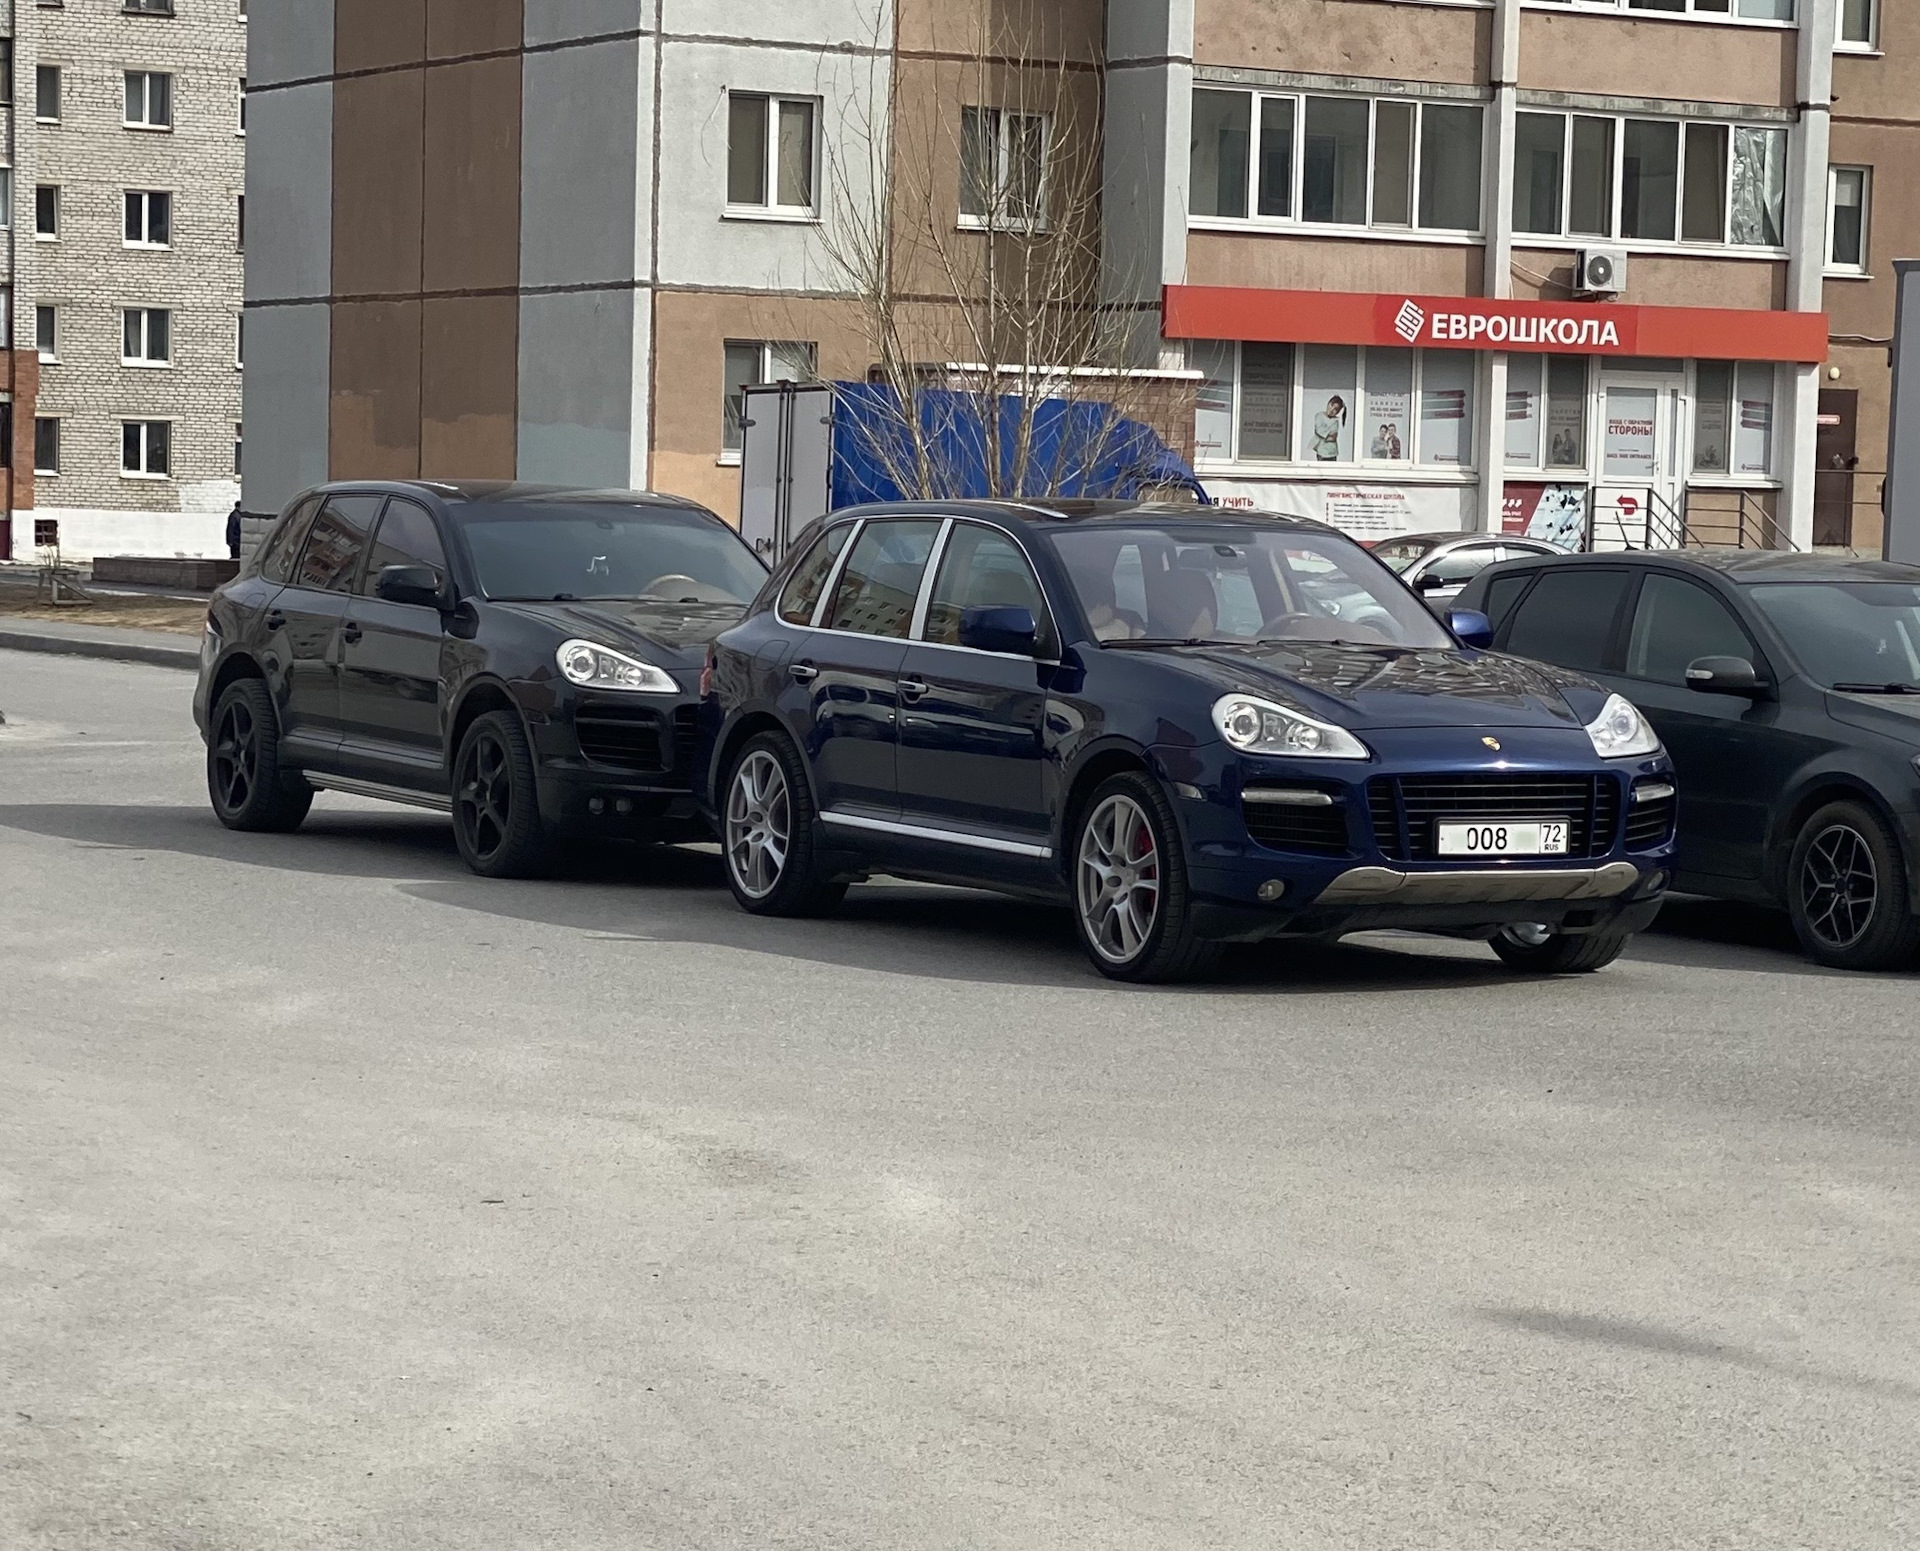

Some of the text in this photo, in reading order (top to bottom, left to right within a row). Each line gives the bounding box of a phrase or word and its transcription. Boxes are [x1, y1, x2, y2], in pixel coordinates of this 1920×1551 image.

[1431, 312, 1620, 346] ЕВРОШКОЛА
[1608, 425, 1653, 436] СТОРОНЫ
[1222, 497, 1254, 507] УЧИТЬ
[1542, 825, 1561, 843] 72
